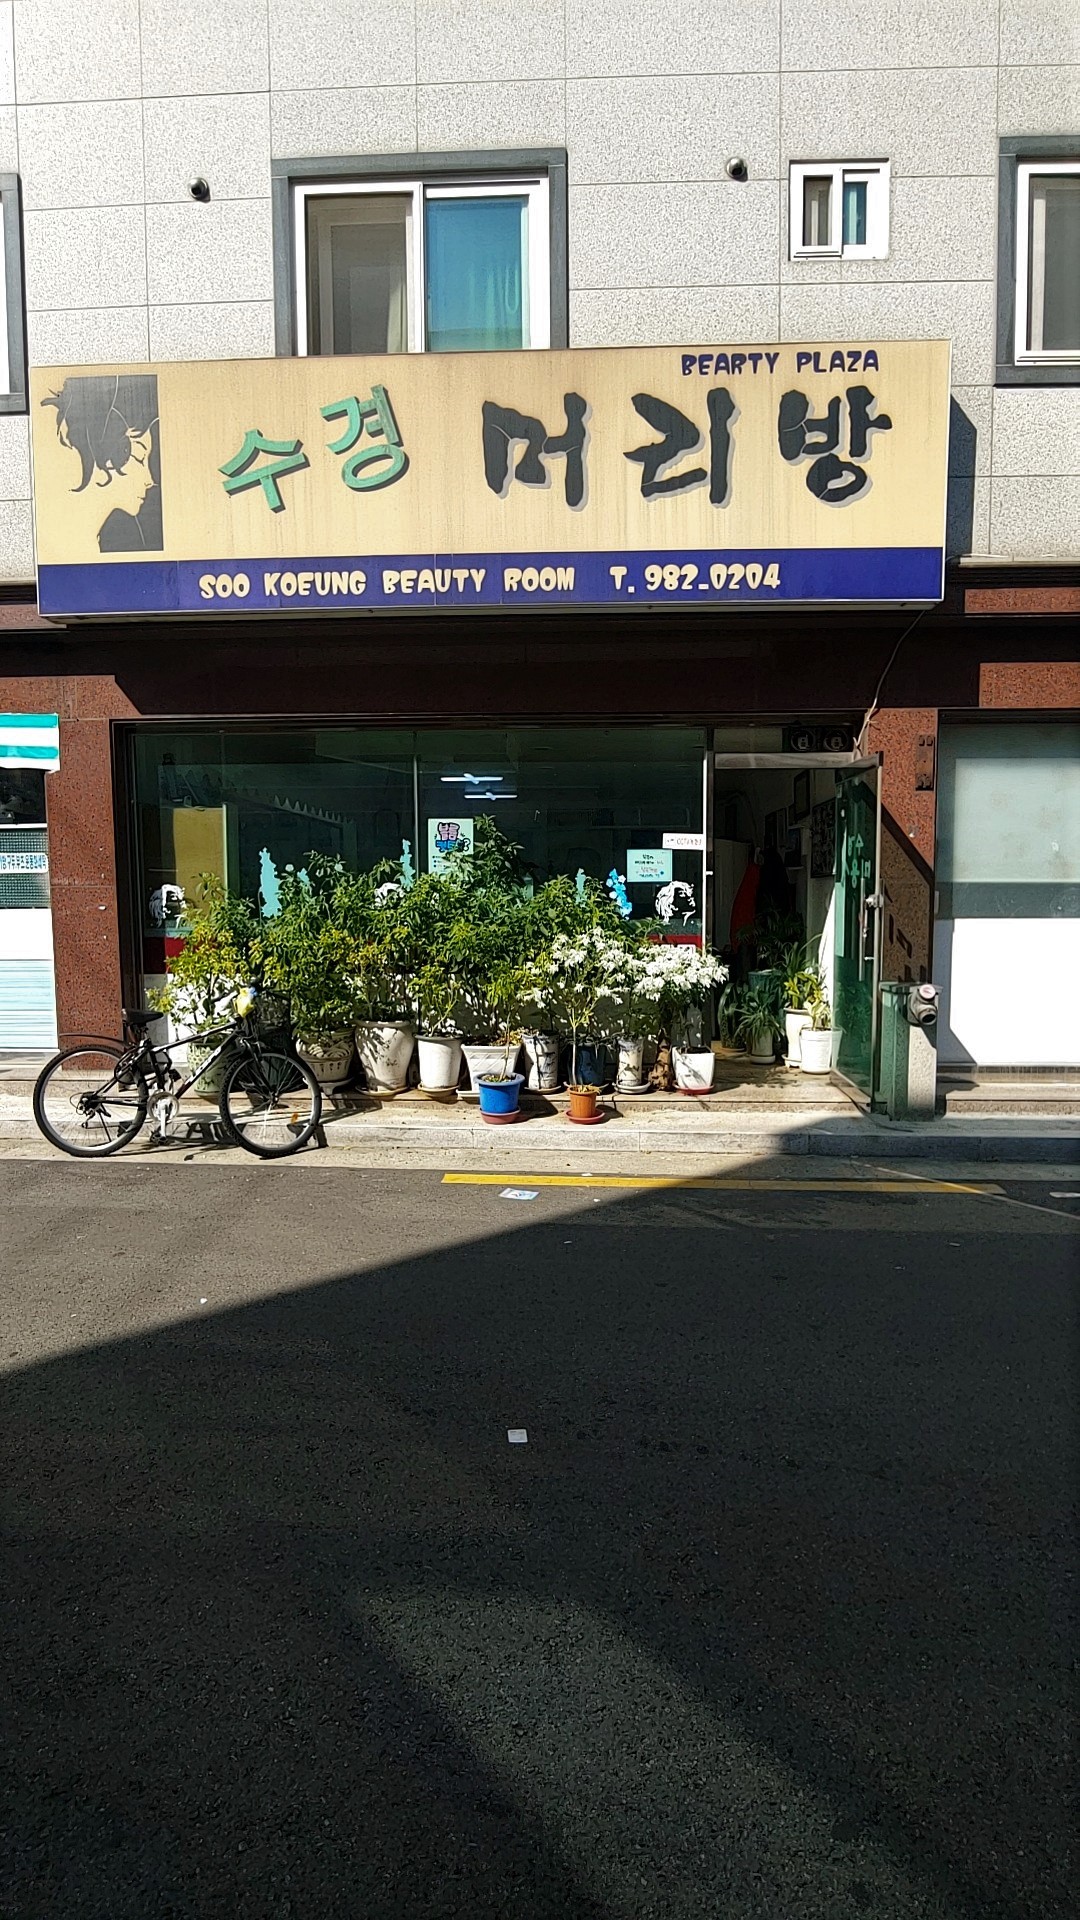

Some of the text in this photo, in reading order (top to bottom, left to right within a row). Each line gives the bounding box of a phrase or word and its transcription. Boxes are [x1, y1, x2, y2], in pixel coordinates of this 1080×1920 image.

[681, 350, 879, 376] BEARTY PLAZA
[218, 384, 893, 514] 수경 머리방
[199, 573, 250, 599] SOO
[263, 570, 367, 597] KOEUNG
[382, 568, 486, 594] BEAUTY
[503, 566, 575, 592] ROOM
